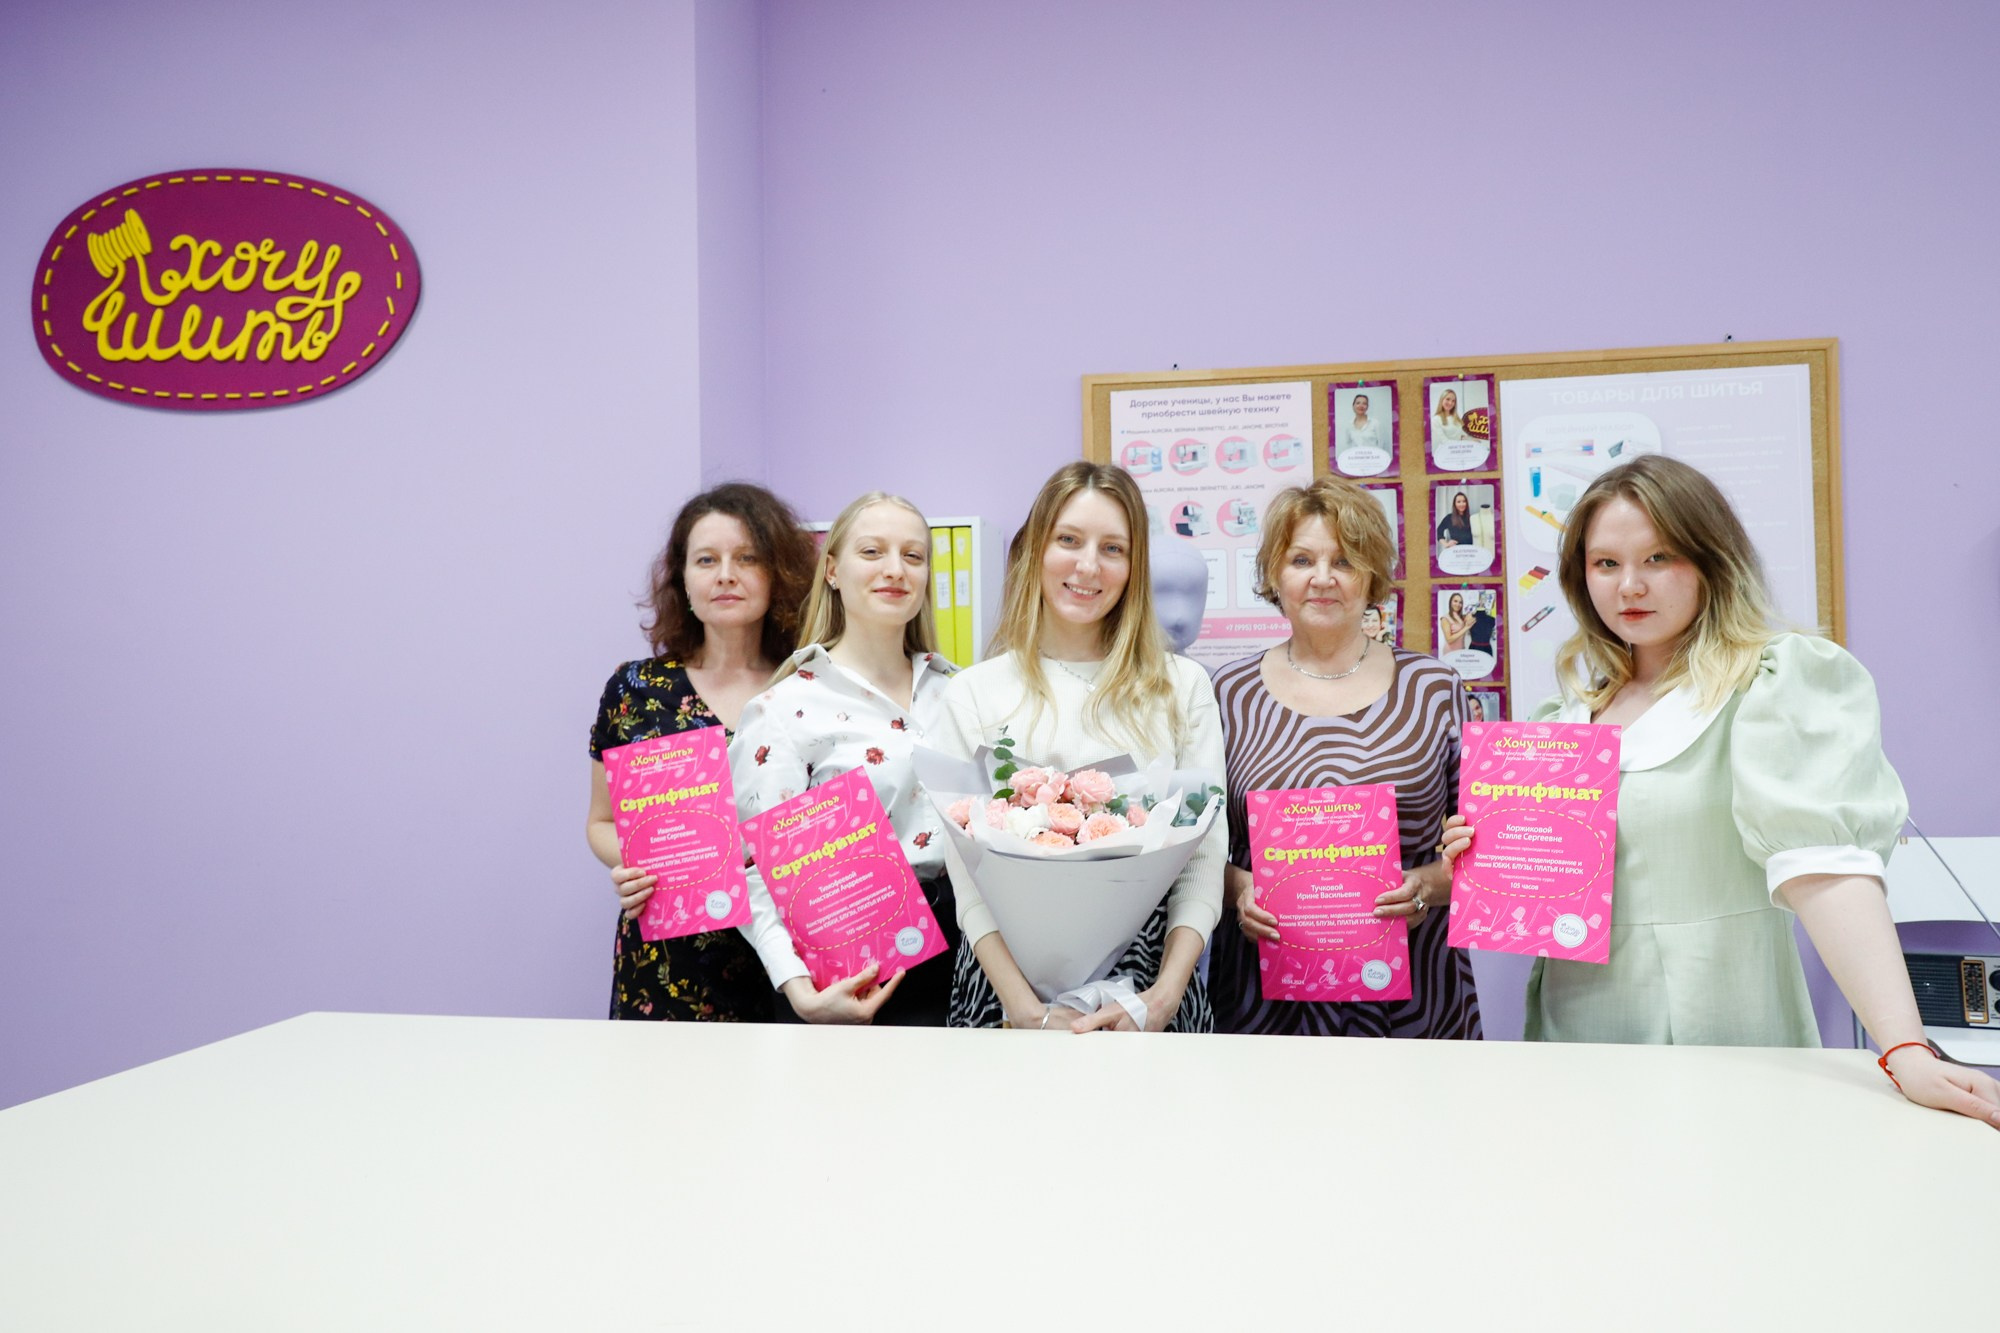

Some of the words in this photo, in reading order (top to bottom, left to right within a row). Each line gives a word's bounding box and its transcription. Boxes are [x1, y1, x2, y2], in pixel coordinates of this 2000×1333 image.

[1129, 398, 1169, 408] Дорогие
[1170, 397, 1213, 408] ученицы,
[1215, 397, 1221, 405] у
[1223, 395, 1240, 403] нас
[1242, 394, 1255, 402] Вы
[1257, 392, 1292, 401] можете
[1550, 389, 1635, 405] ТОВАРЫ
[1640, 385, 1684, 402] ДЛЯ
[1690, 380, 1764, 398] ШИТЬЯ
[1141, 408, 1196, 419] приобрести
[1198, 405, 1241, 416] швейную
[1243, 404, 1280, 414] технику
[1495, 736, 1534, 750] «Хочу
[1537, 740, 1578, 749] шить»
[629, 753, 660, 767] «Хочу
[661, 748, 694, 761] шить»
[619, 781, 719, 813] Сертификат
[1470, 780, 1602, 803] Сертификат
[773, 812, 804, 831] «Хочу
[806, 795, 839, 815] шить»
[1283, 801, 1321, 817] «Хочу
[1323, 803, 1361, 812] шить»
[1497, 831, 1522, 839] Стэлле
[1522, 833, 1562, 842] Сергеевне
[1505, 823, 1552, 836] Коржиковой
[771, 821, 876, 879] Сертификат
[1263, 843, 1387, 865] Сертификат
[1475, 852, 1526, 862] Конструирование,
[1527, 857, 1576, 866] моделирование
[1492, 861, 1510, 869] ЮБКИ,
[1511, 862, 1533, 871] БЛУЗЫ,
[1533, 864, 1558, 872] ПЛАТЬЯ
[808, 887, 840, 906] Анастасии
[840, 871, 873, 891] Андреевне
[817, 870, 856, 893] Тимофеевой
[1310, 883, 1343, 892] Тучковой
[1296, 891, 1319, 900] Ирине
